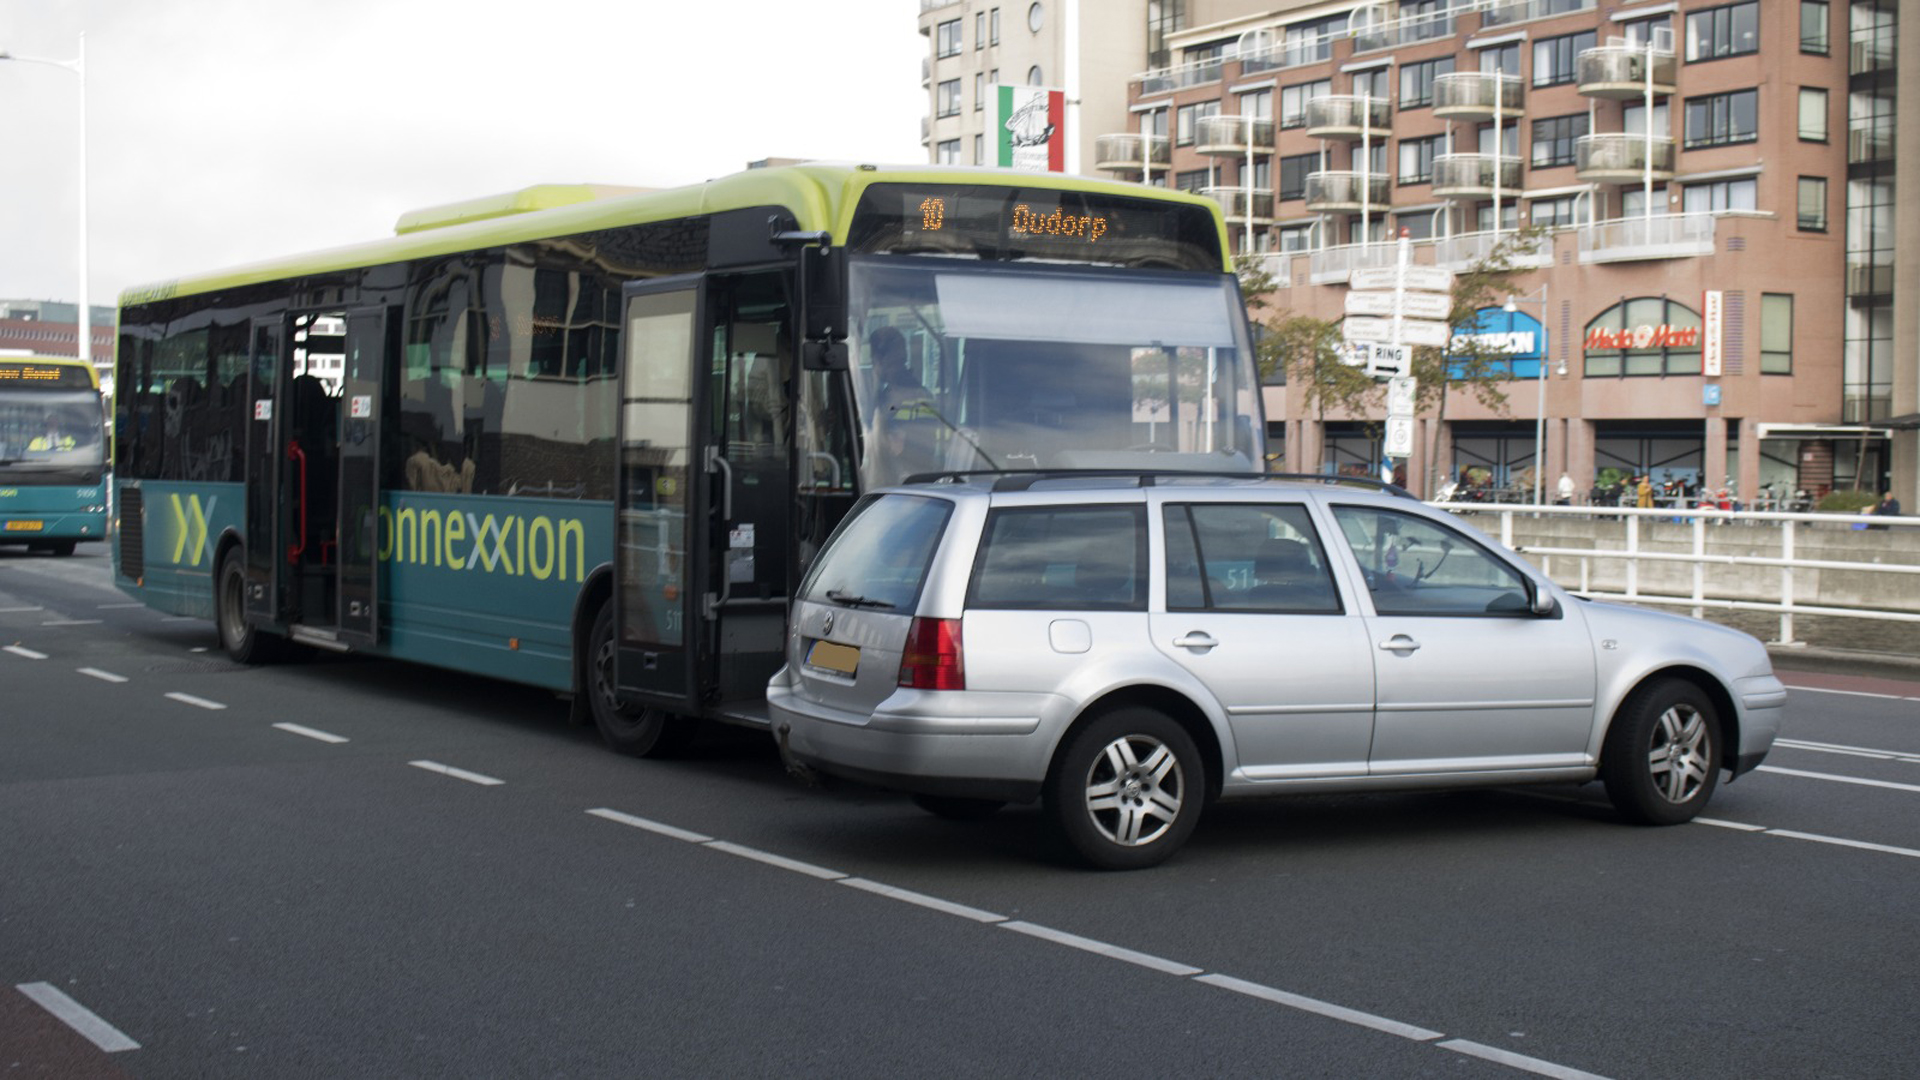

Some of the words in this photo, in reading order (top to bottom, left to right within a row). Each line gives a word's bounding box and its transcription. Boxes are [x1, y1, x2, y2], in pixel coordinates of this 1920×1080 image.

[919, 197, 944, 231] 10
[1013, 204, 1107, 242] Oudorp
[1583, 326, 1634, 349] Media
[1648, 324, 1698, 347] Markt
[1375, 347, 1403, 361] RING
